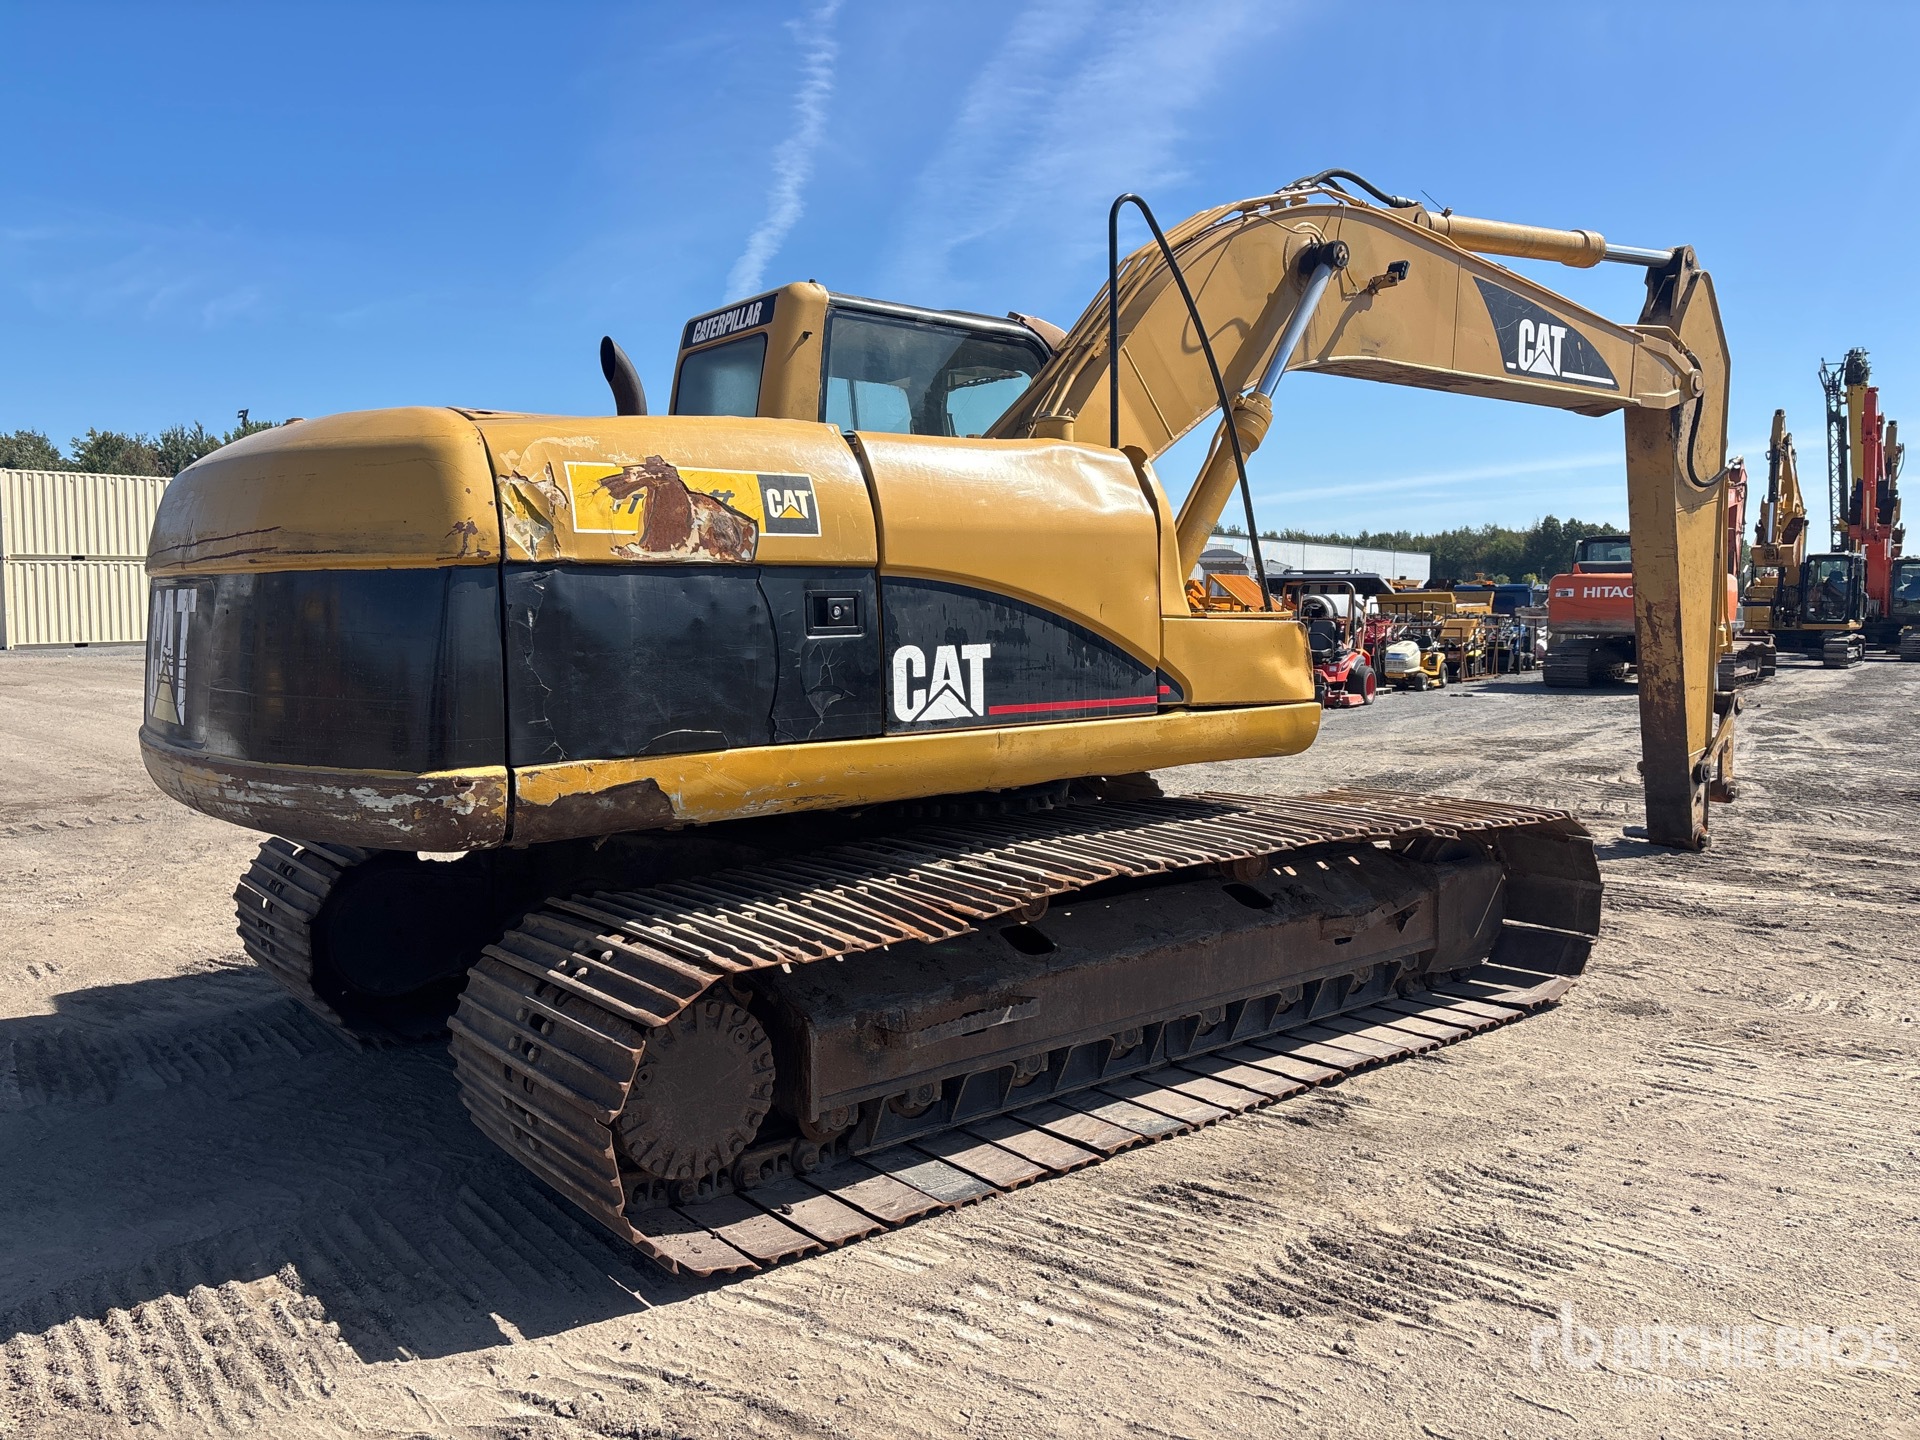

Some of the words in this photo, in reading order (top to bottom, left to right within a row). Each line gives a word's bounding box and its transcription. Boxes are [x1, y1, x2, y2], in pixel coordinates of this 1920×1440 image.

[692, 301, 763, 343] CATERPILLAR
[1518, 318, 1566, 377] CAT
[766, 488, 811, 519] CAT
[893, 643, 992, 722] CAT
